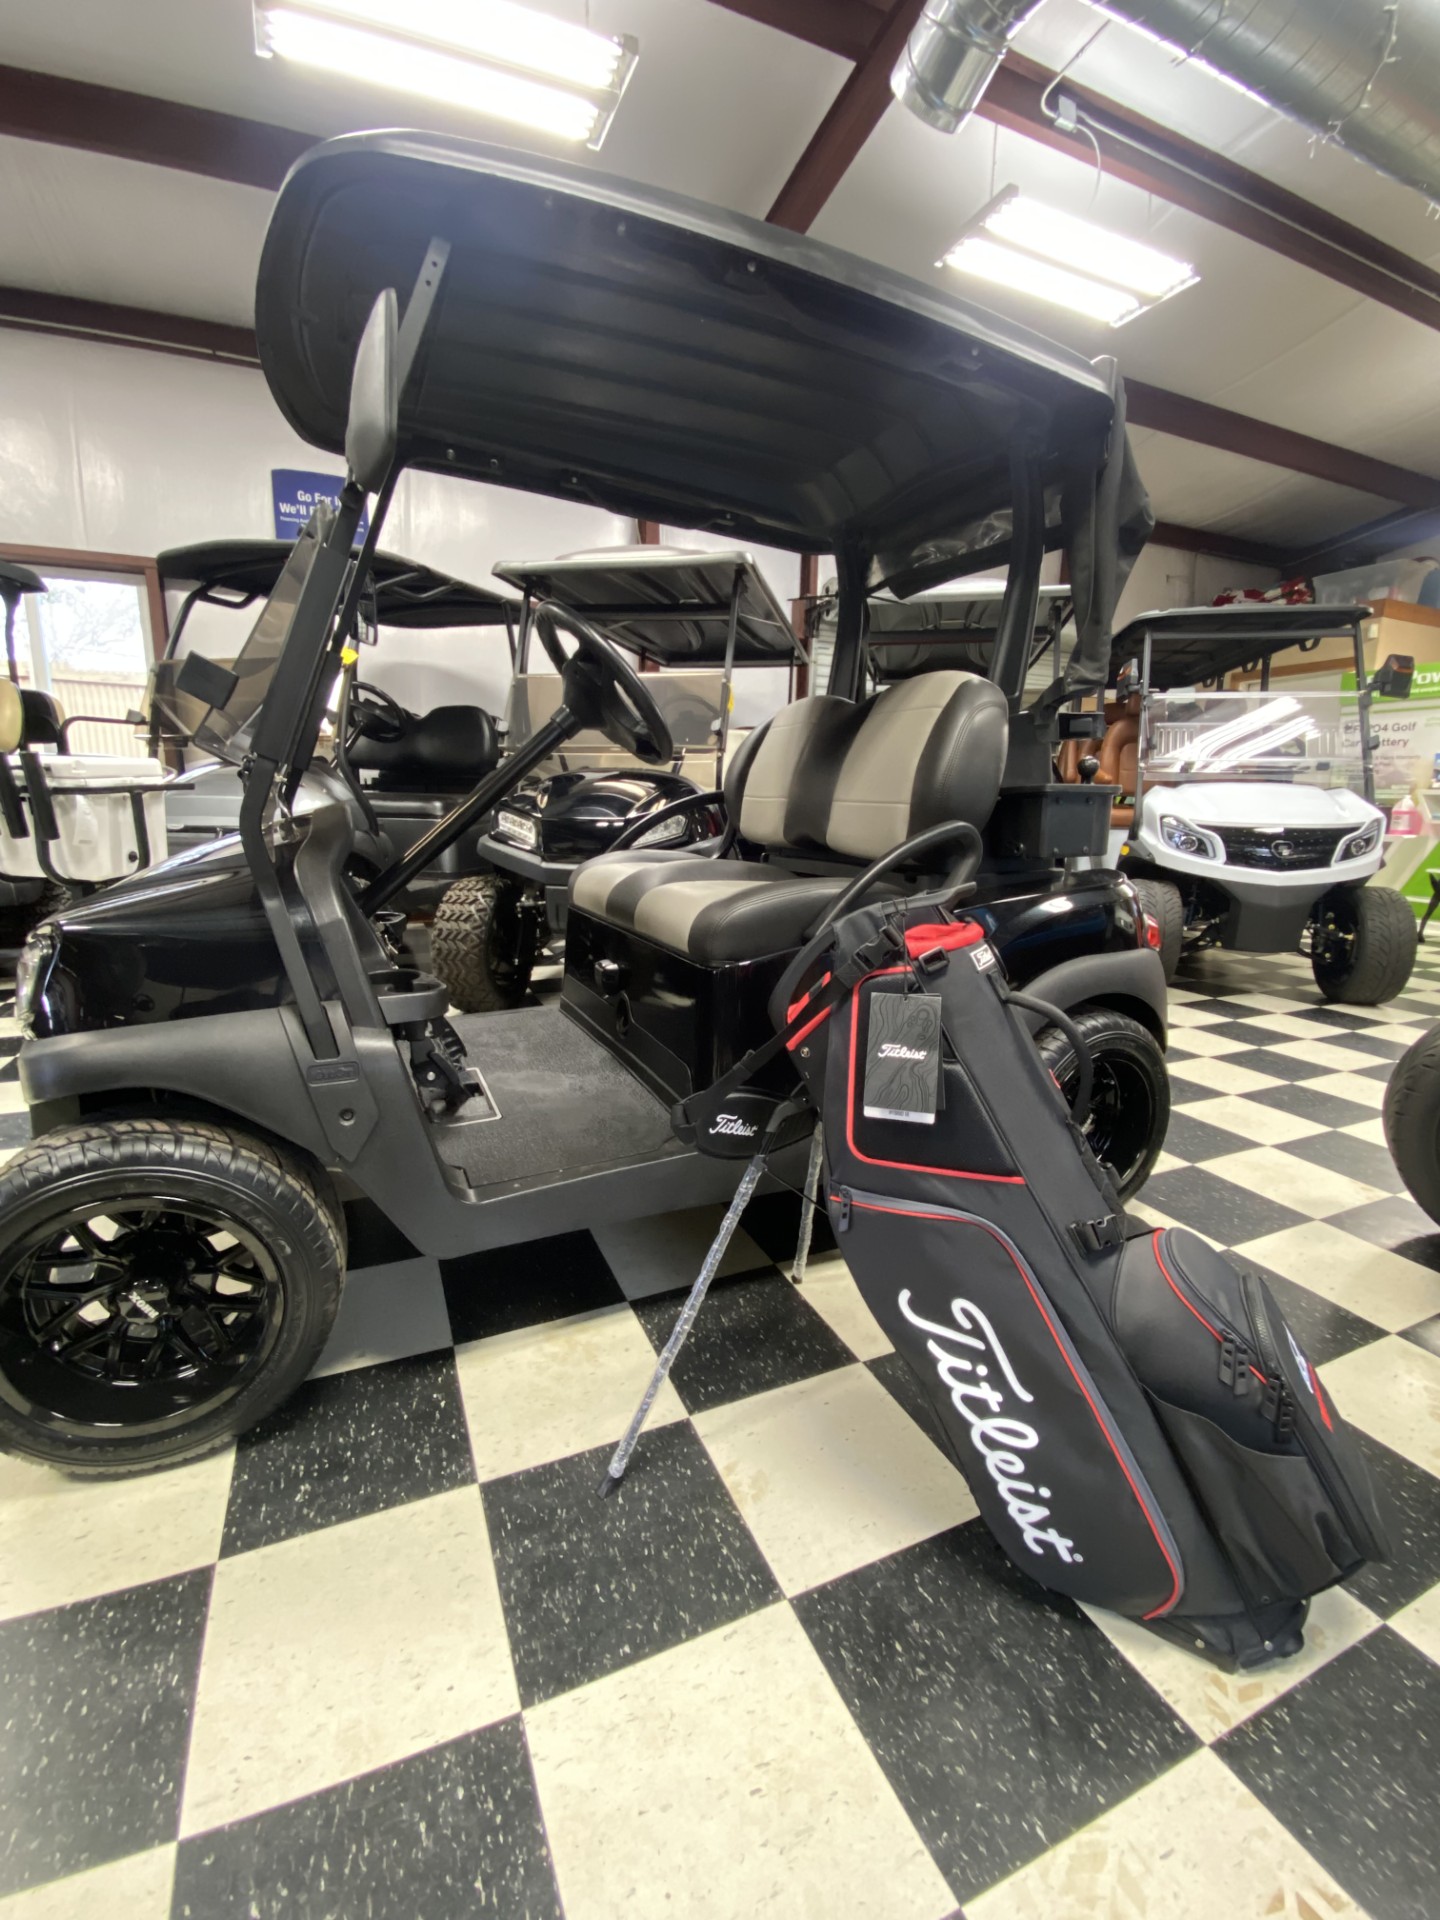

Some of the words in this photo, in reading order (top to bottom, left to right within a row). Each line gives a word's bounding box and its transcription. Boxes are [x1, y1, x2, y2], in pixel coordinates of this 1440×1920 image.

[297, 490, 312, 502] Go
[314, 492, 332, 505] For
[279, 502, 307, 515] We'll
[1392, 722, 1417, 732] Golf
[878, 1043, 928, 1060] Titleist
[708, 1113, 758, 1137] Titleist
